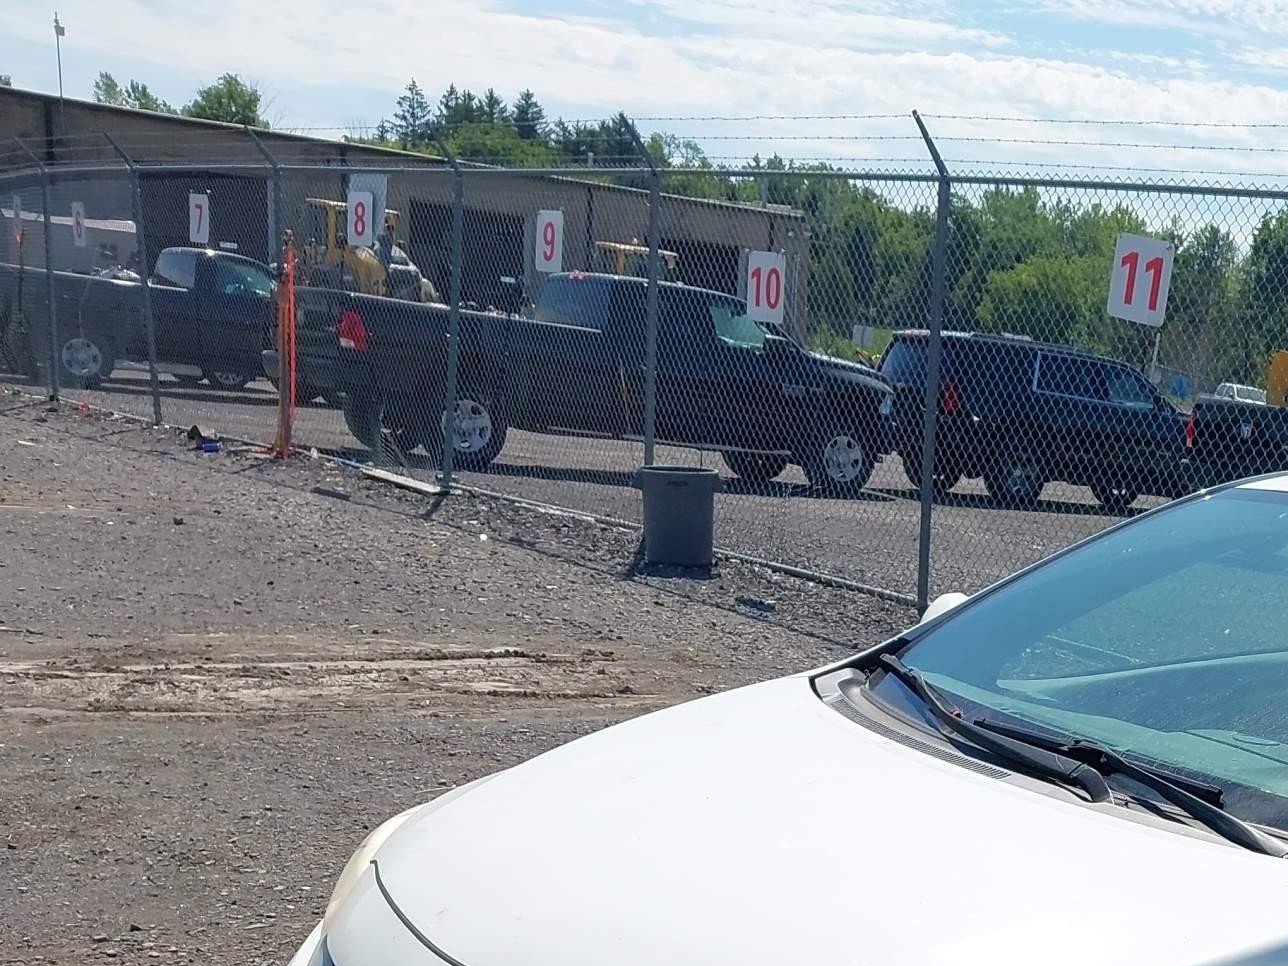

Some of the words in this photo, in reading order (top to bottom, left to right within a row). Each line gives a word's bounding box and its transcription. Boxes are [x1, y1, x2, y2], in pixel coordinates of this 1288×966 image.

[74, 210, 83, 239] 6
[195, 203, 203, 234] 7
[353, 201, 366, 237] 8
[543, 221, 555, 262] 9
[751, 266, 781, 310] 10
[1121, 251, 1164, 312] 11
